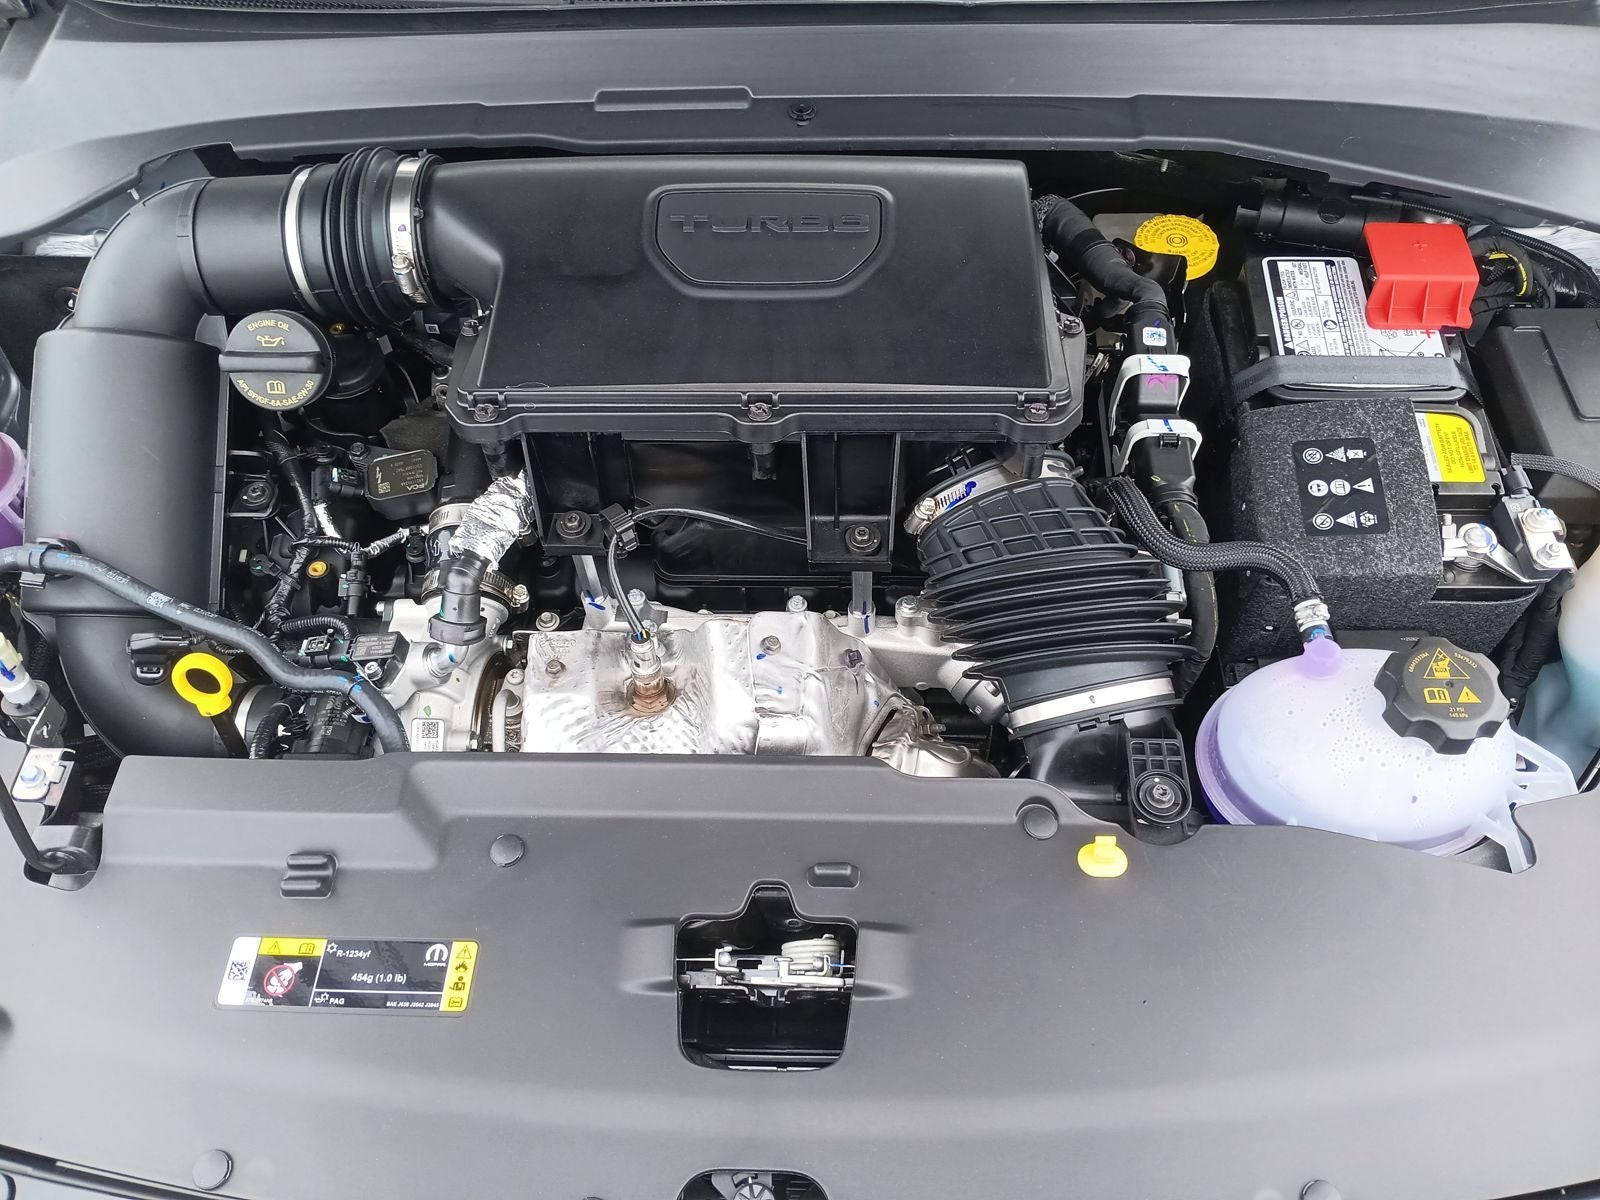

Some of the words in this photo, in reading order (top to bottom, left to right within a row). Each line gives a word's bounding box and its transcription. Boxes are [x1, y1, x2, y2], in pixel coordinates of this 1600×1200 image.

[670, 214, 871, 233] TURBO
[246, 319, 277, 332] ENGINE
[277, 320, 291, 332] OIL
[1277, 297, 1292, 342] DANGER/POISON
[236, 379, 248, 392] API
[406, 483, 425, 491] FCA
[336, 950, 371, 959] R-1234yf
[351, 973, 373, 984] 454g
[375, 973, 393, 984] (1.0
[394, 973, 407, 984] lb)
[329, 997, 345, 1005] PAG
